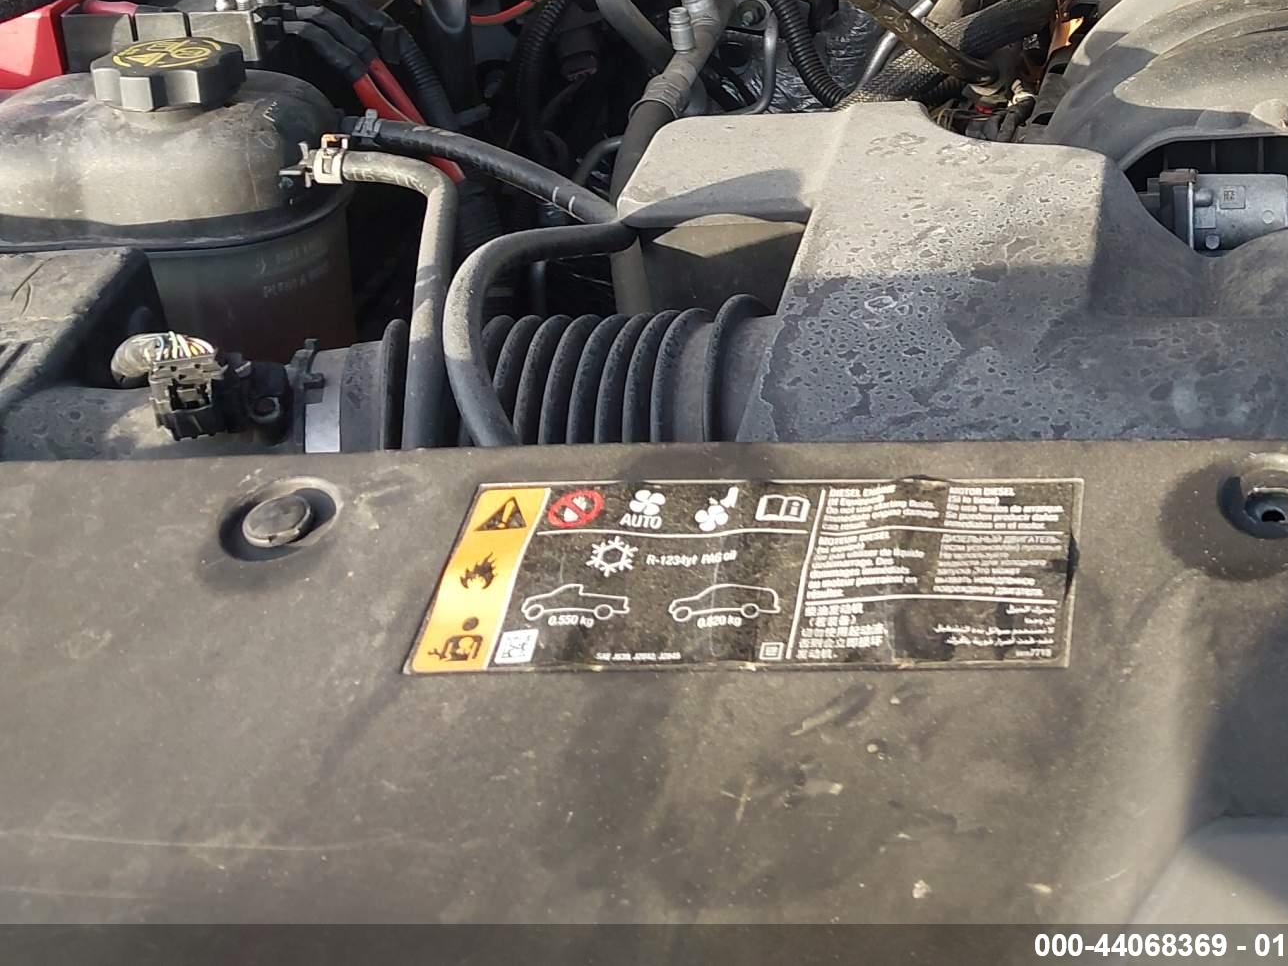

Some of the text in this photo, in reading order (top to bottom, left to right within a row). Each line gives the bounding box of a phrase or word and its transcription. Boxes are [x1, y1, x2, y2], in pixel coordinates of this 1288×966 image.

[620, 513, 662, 529] AUTO
[723, 550, 737, 561] oil
[548, 615, 594, 627] 0.550 kg
[728, 615, 742, 627] kg
